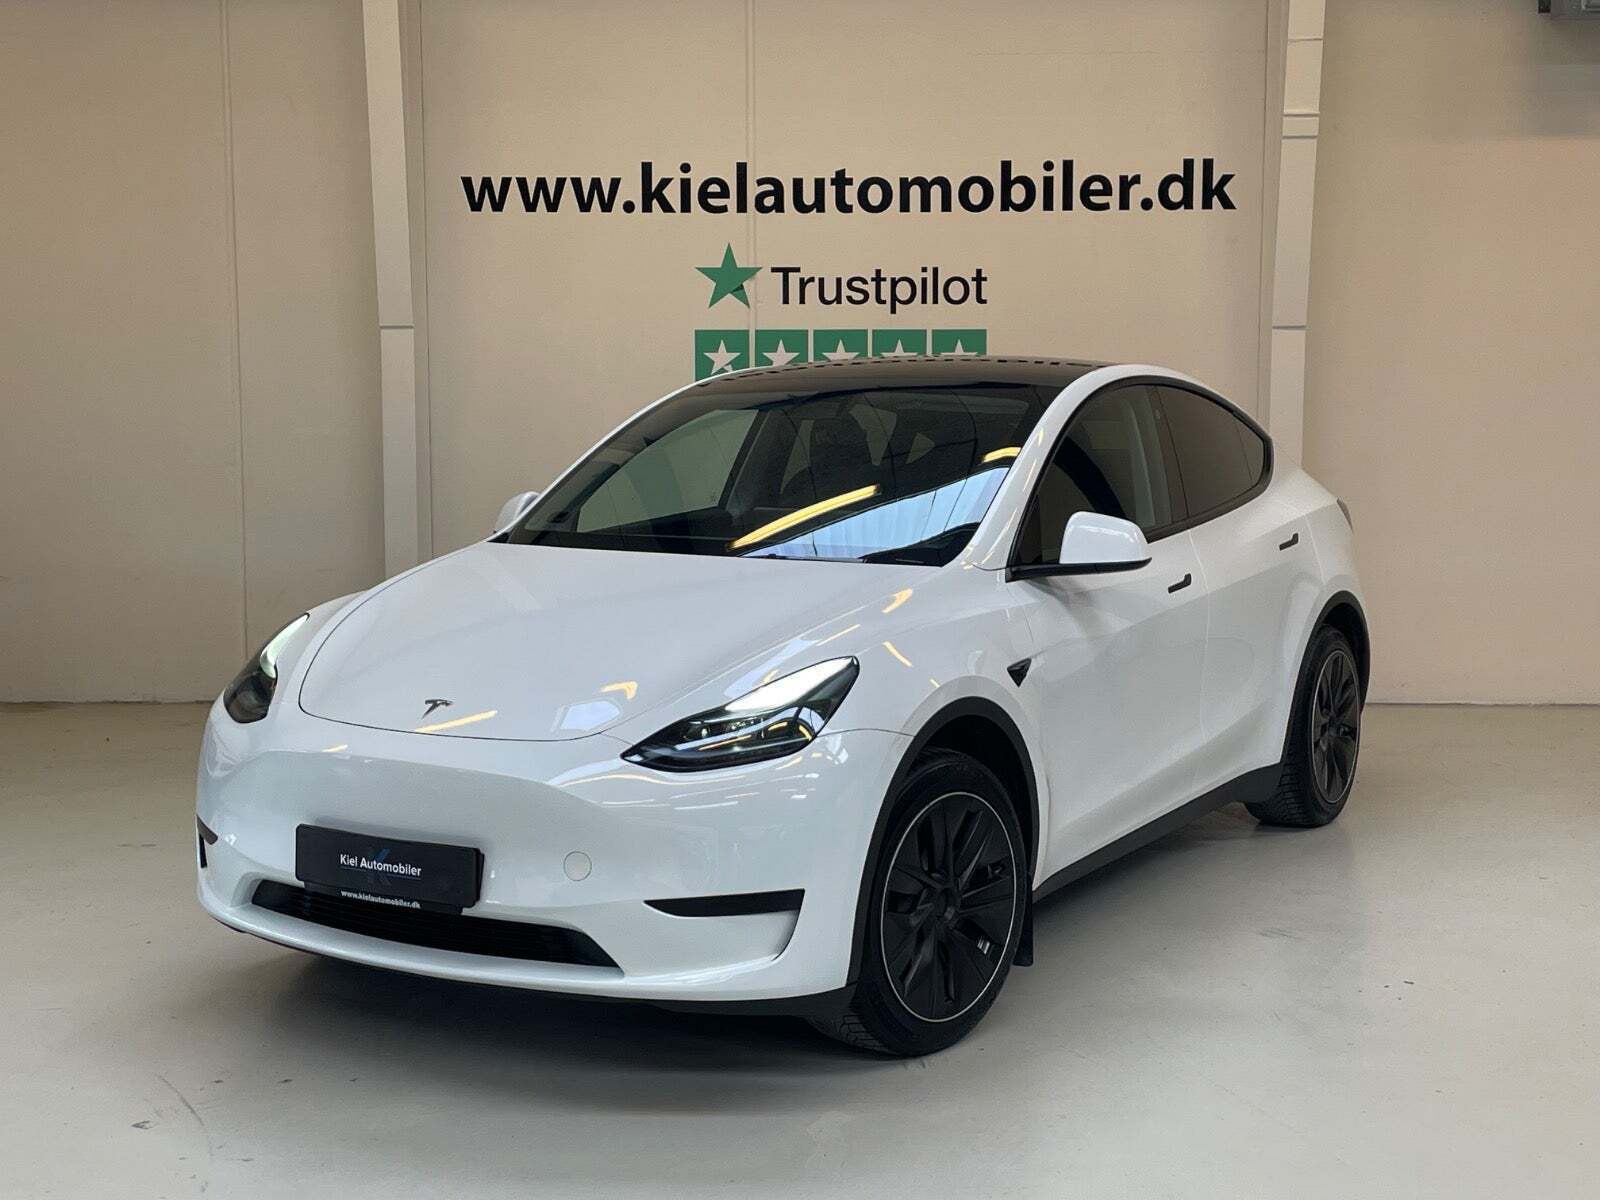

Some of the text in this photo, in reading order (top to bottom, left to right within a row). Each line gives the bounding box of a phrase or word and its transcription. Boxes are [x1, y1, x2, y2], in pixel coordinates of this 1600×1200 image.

[461, 158, 1236, 213] www.kielautomobiler.dk
[771, 266, 988, 314] Trustpilot
[339, 853, 422, 877] Kiel Automobiler
[340, 890, 421, 909] www.kielautomobiler.dk
